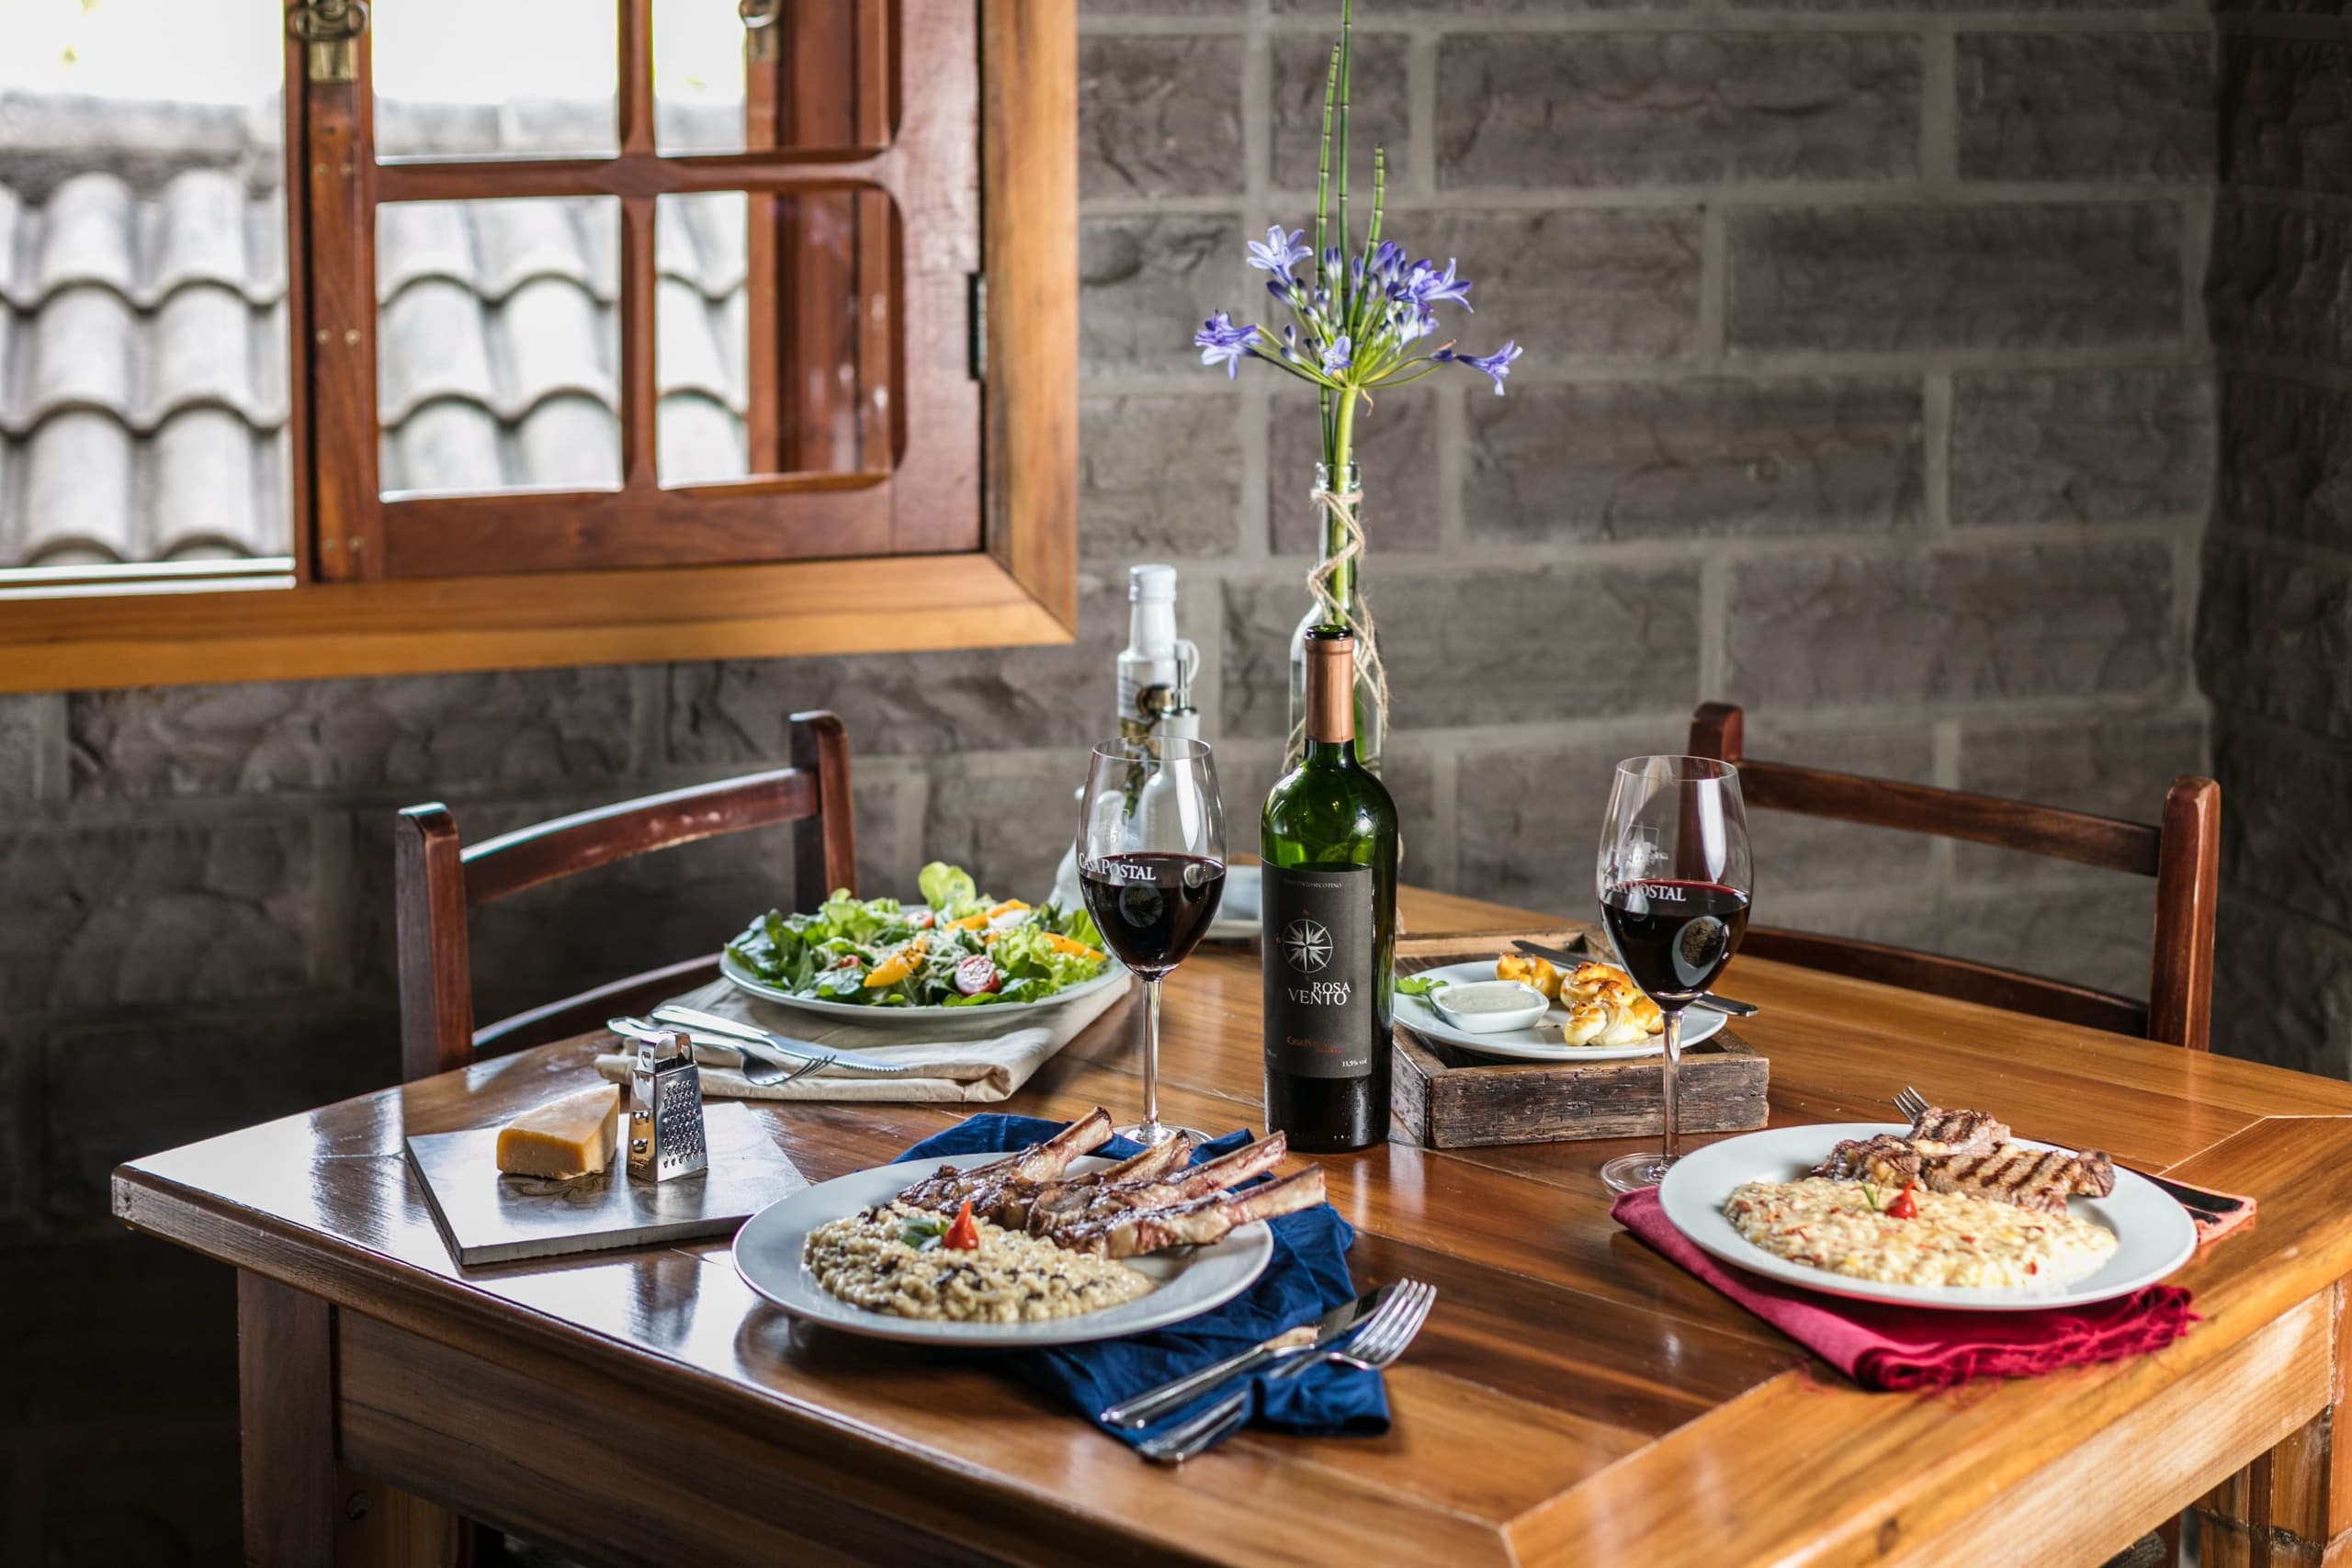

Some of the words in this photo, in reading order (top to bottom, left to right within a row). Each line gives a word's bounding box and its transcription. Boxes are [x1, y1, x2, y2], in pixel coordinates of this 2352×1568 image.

[1079, 852, 1101, 873] CASA
[1102, 858, 1156, 880] POSTAL
[1288, 987, 1347, 1005] VENTO
[1313, 981, 1351, 993] ROSA
